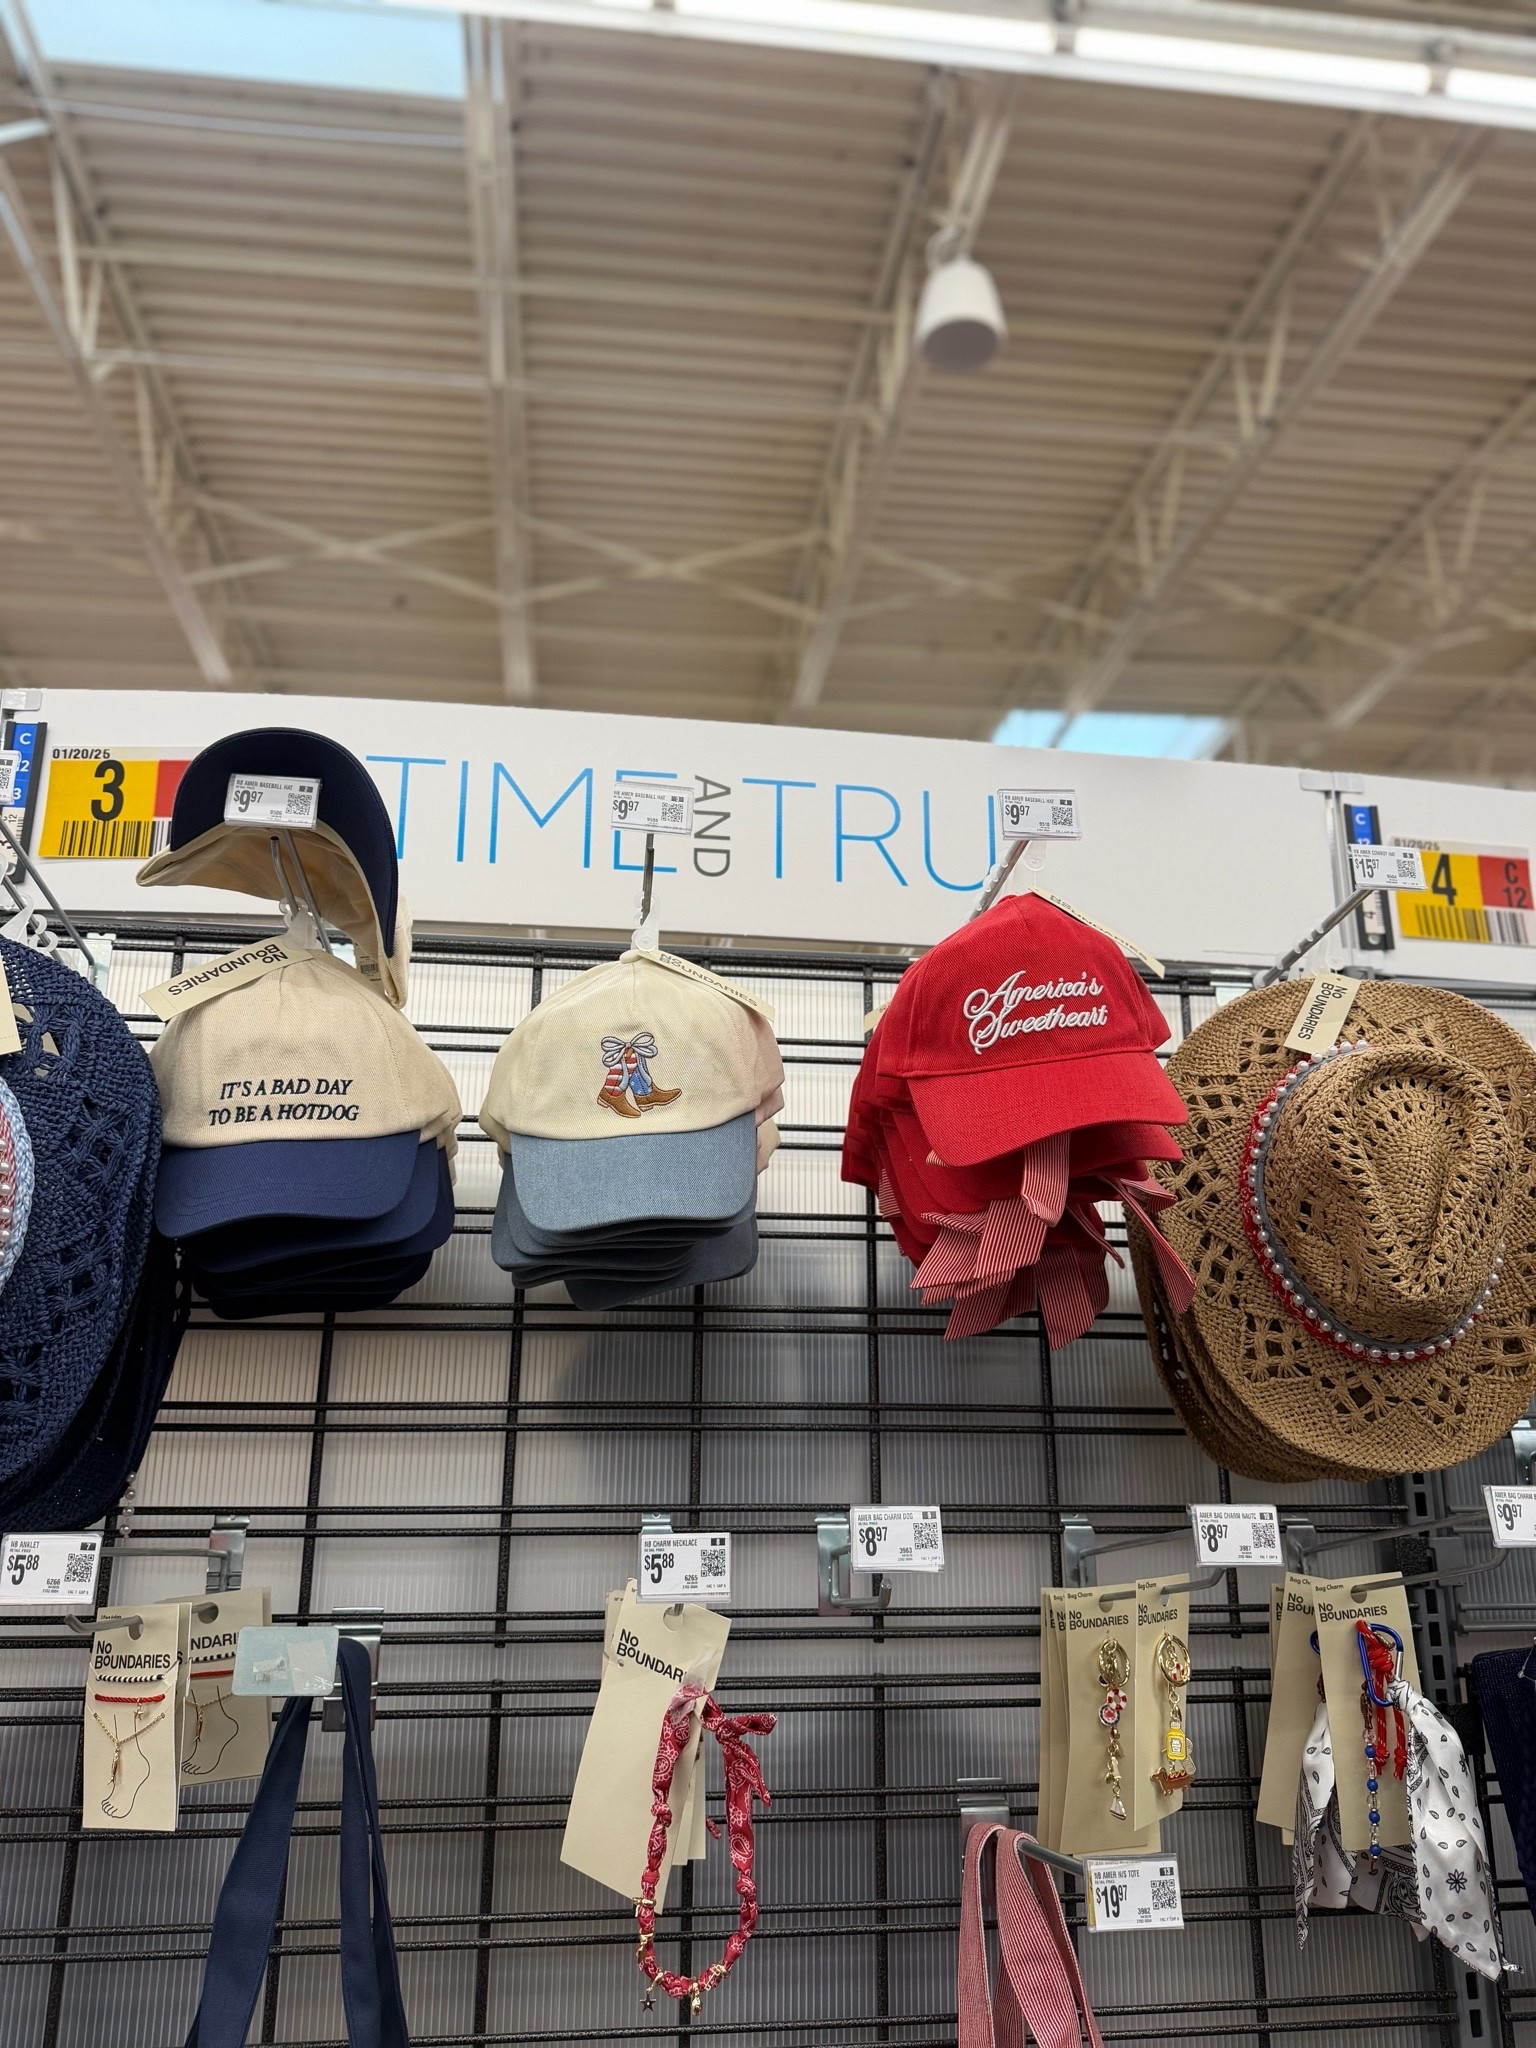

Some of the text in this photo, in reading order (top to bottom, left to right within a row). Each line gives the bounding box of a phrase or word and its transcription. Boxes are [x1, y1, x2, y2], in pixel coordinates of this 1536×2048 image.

[20, 732, 32, 744] C
[52, 748, 111, 760] 01/20/25
[14, 788, 22, 800] 3
[90, 759, 126, 822] 3
[259, 782, 282, 790] BASEBALL
[635, 792, 656, 800] BASEBALL
[366, 755, 996, 892] TIME AND TRU
[1355, 813, 1366, 825] C
[1431, 854, 1457, 906] 4
[1504, 860, 1518, 884] C
[1502, 888, 1528, 908] 12
[962, 970, 1104, 1020] America's
[968, 1004, 1108, 1055] Sweetheart
[220, 1078, 354, 1100] IT'S A BAD DAY
[208, 1104, 360, 1126] TO BE A HOTDOG
[19, 1541, 40, 1549] ANKLET
[673, 1539, 698, 1547] NECKLACE
[1290, 1576, 1301, 1584] Bag
[1320, 1606, 1387, 1622] BOUNDARIES
[1069, 1615, 1129, 1630] BOUNDARIES
[94, 1654, 171, 1670] BOUNDARIES
[616, 1642, 684, 1683] BOUNDAR
[1103, 1870, 1117, 1879] AMER
